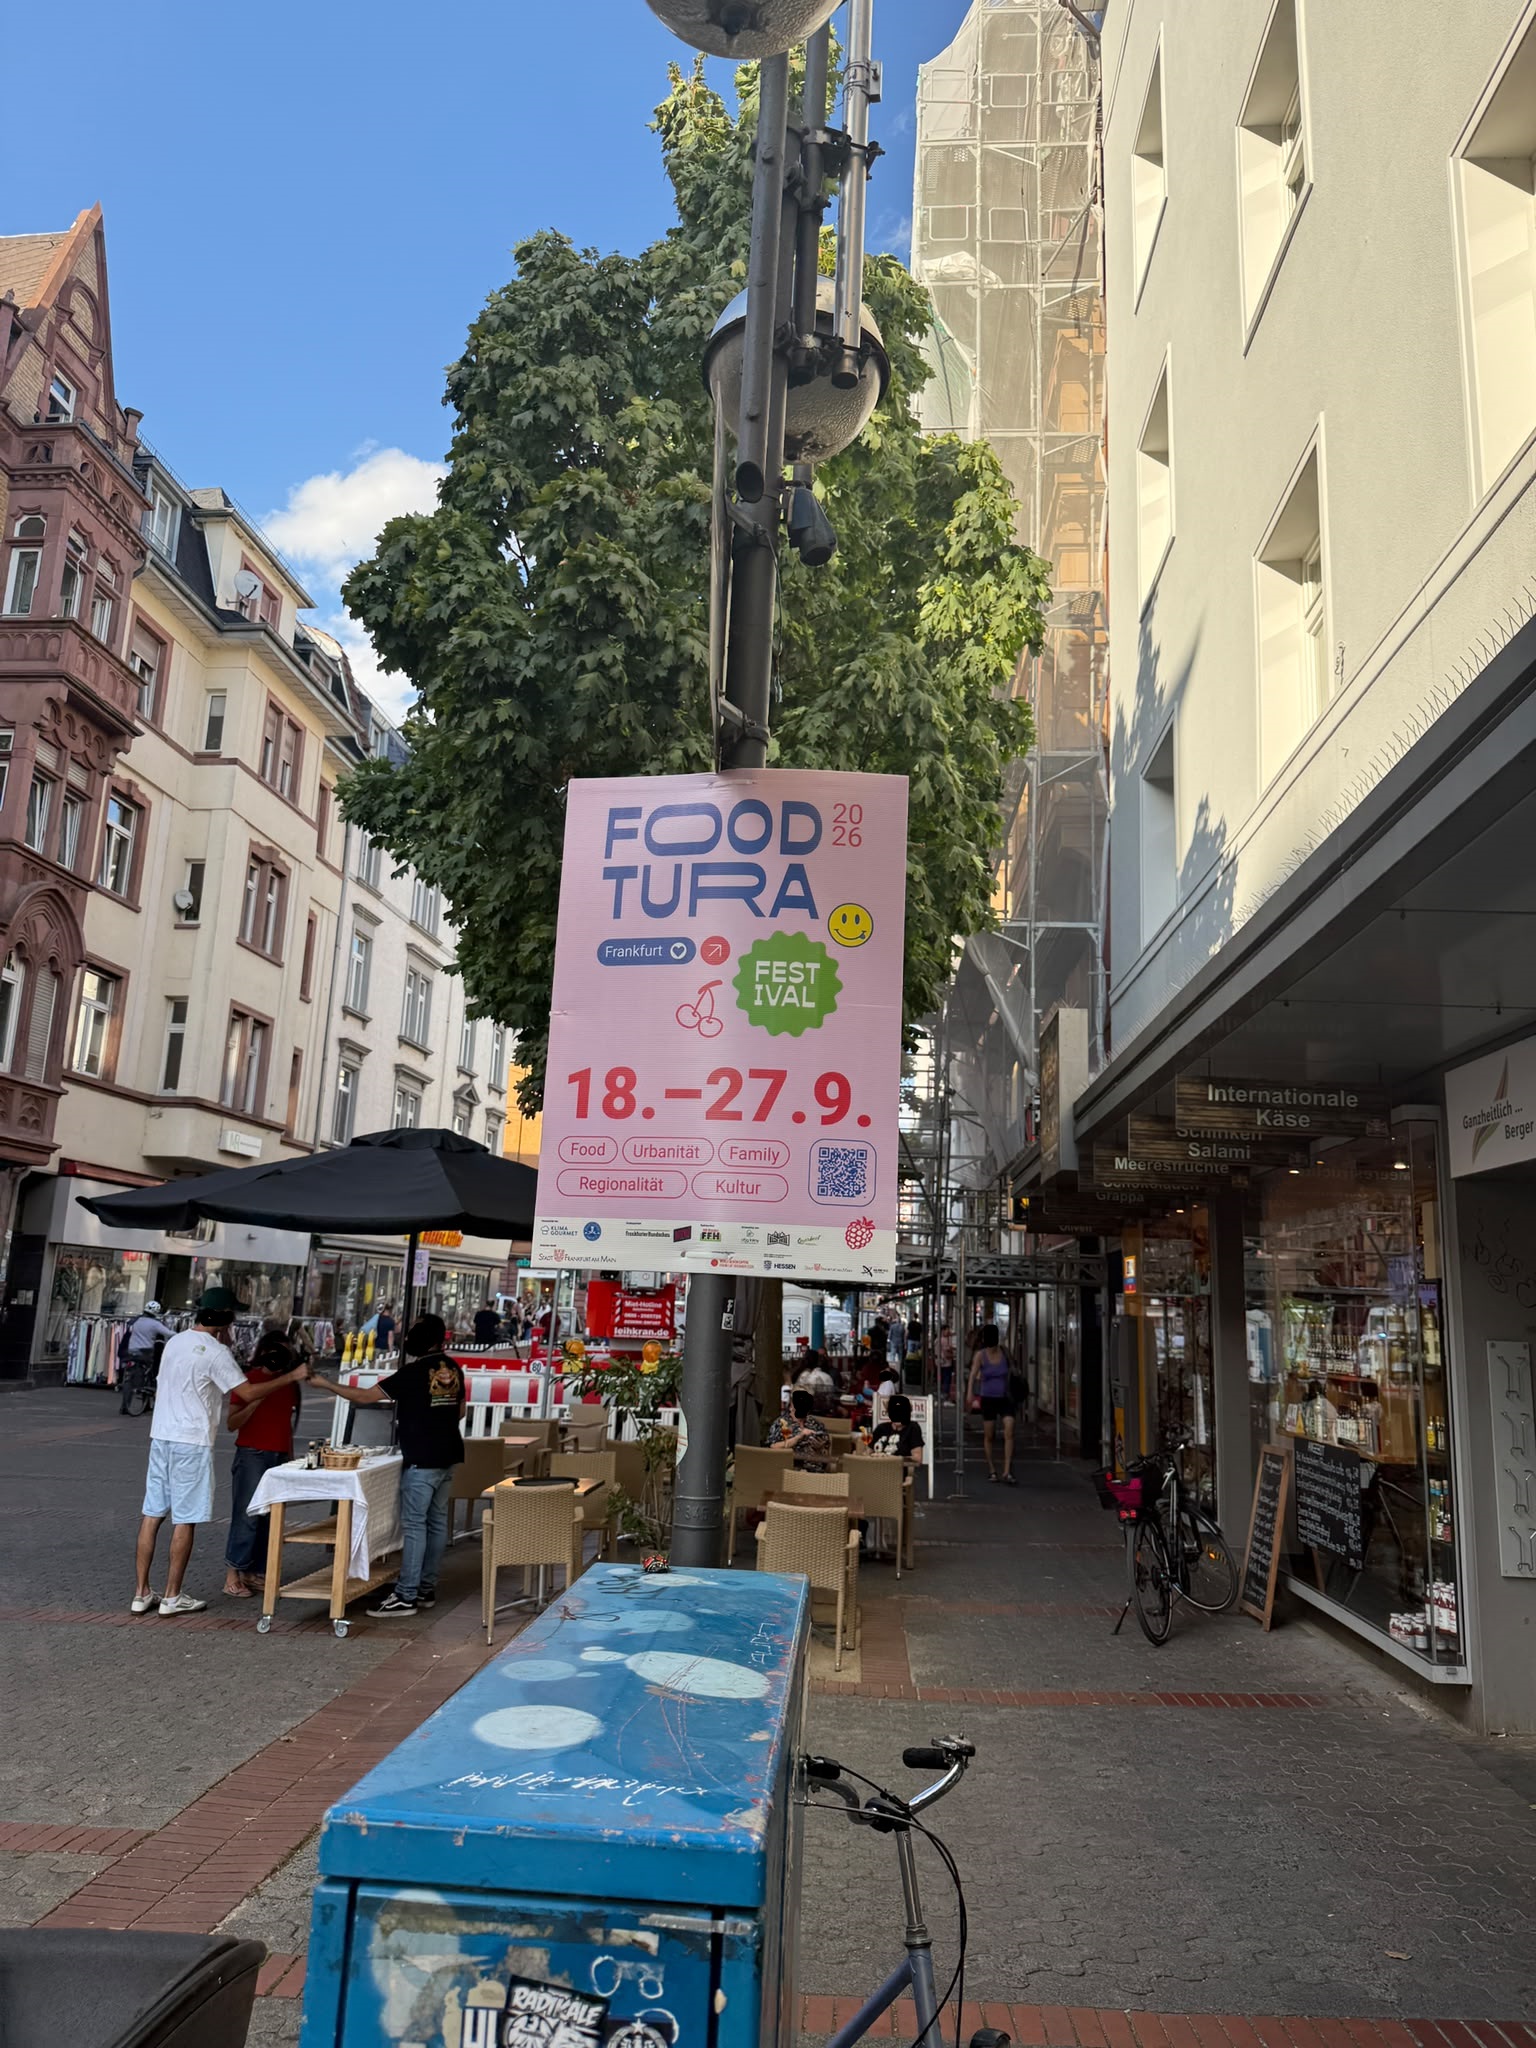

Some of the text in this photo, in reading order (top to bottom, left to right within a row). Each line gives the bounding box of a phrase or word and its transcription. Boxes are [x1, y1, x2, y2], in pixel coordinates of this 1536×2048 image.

[832, 802, 864, 825] 20
[604, 799, 823, 859] FOOD
[832, 825, 863, 848] 26
[602, 862, 820, 920] TURA
[604, 943, 663, 959] Frankfurt
[755, 961, 821, 985] FEST
[754, 985, 816, 1009] IVAL
[1207, 1083, 1360, 1109] Internationale
[1256, 1108, 1311, 1129] Käse
[1463, 1100, 1513, 1129] Ganzheitlich
[570, 1142, 606, 1158] Food
[632, 1144, 700, 1160] Urbanität
[729, 1146, 781, 1166] Family
[1187, 1141, 1252, 1160] Salami
[579, 1176, 665, 1196] Regionalität
[715, 1178, 762, 1196] Kultur
[701, 1231, 720, 1241] FFH
[773, 1263, 796, 1271] HESSEN
[614, 1327, 670, 1336] leihkran.de
[512, 1986, 604, 2027] RADIKALE
